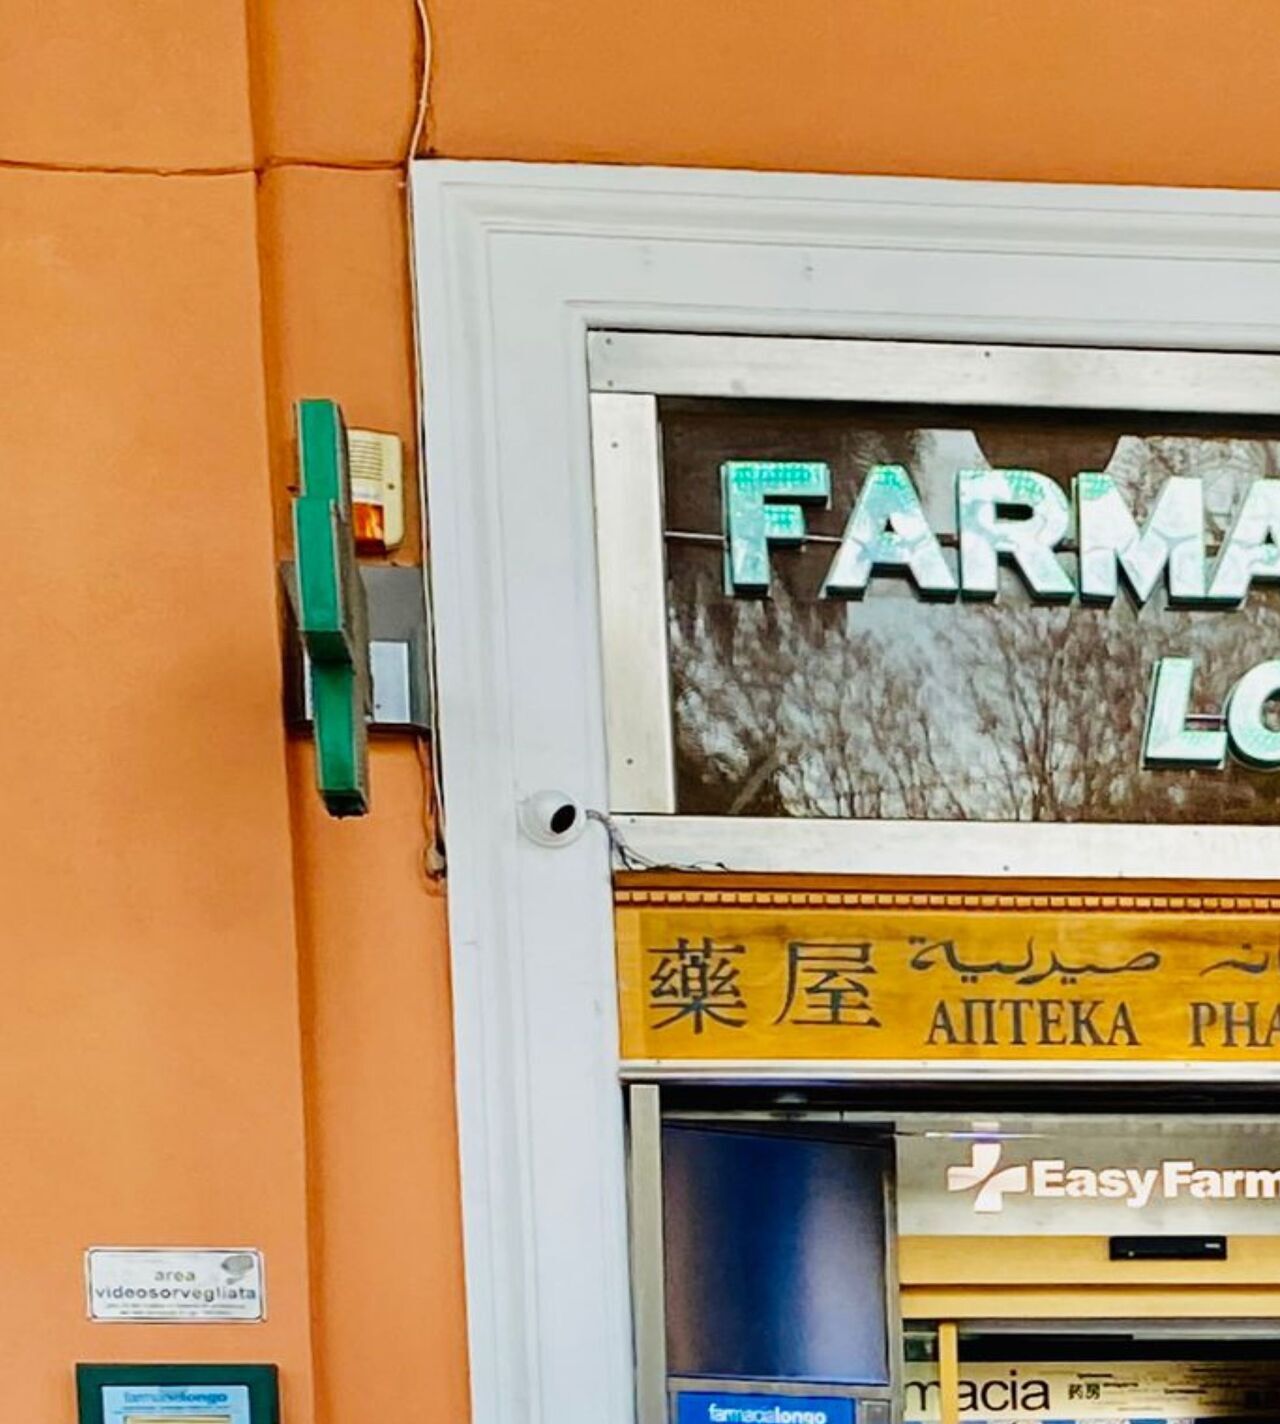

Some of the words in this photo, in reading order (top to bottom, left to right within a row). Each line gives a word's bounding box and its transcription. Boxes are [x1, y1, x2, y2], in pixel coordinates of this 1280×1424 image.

[908, 935, 1161, 985] صيدلية
[647, 937, 883, 1034] 藥屋
[926, 999, 1139, 1046] АПТЕКА
[95, 1284, 257, 1302] videosorvegliata
[154, 1269, 197, 1282] area
